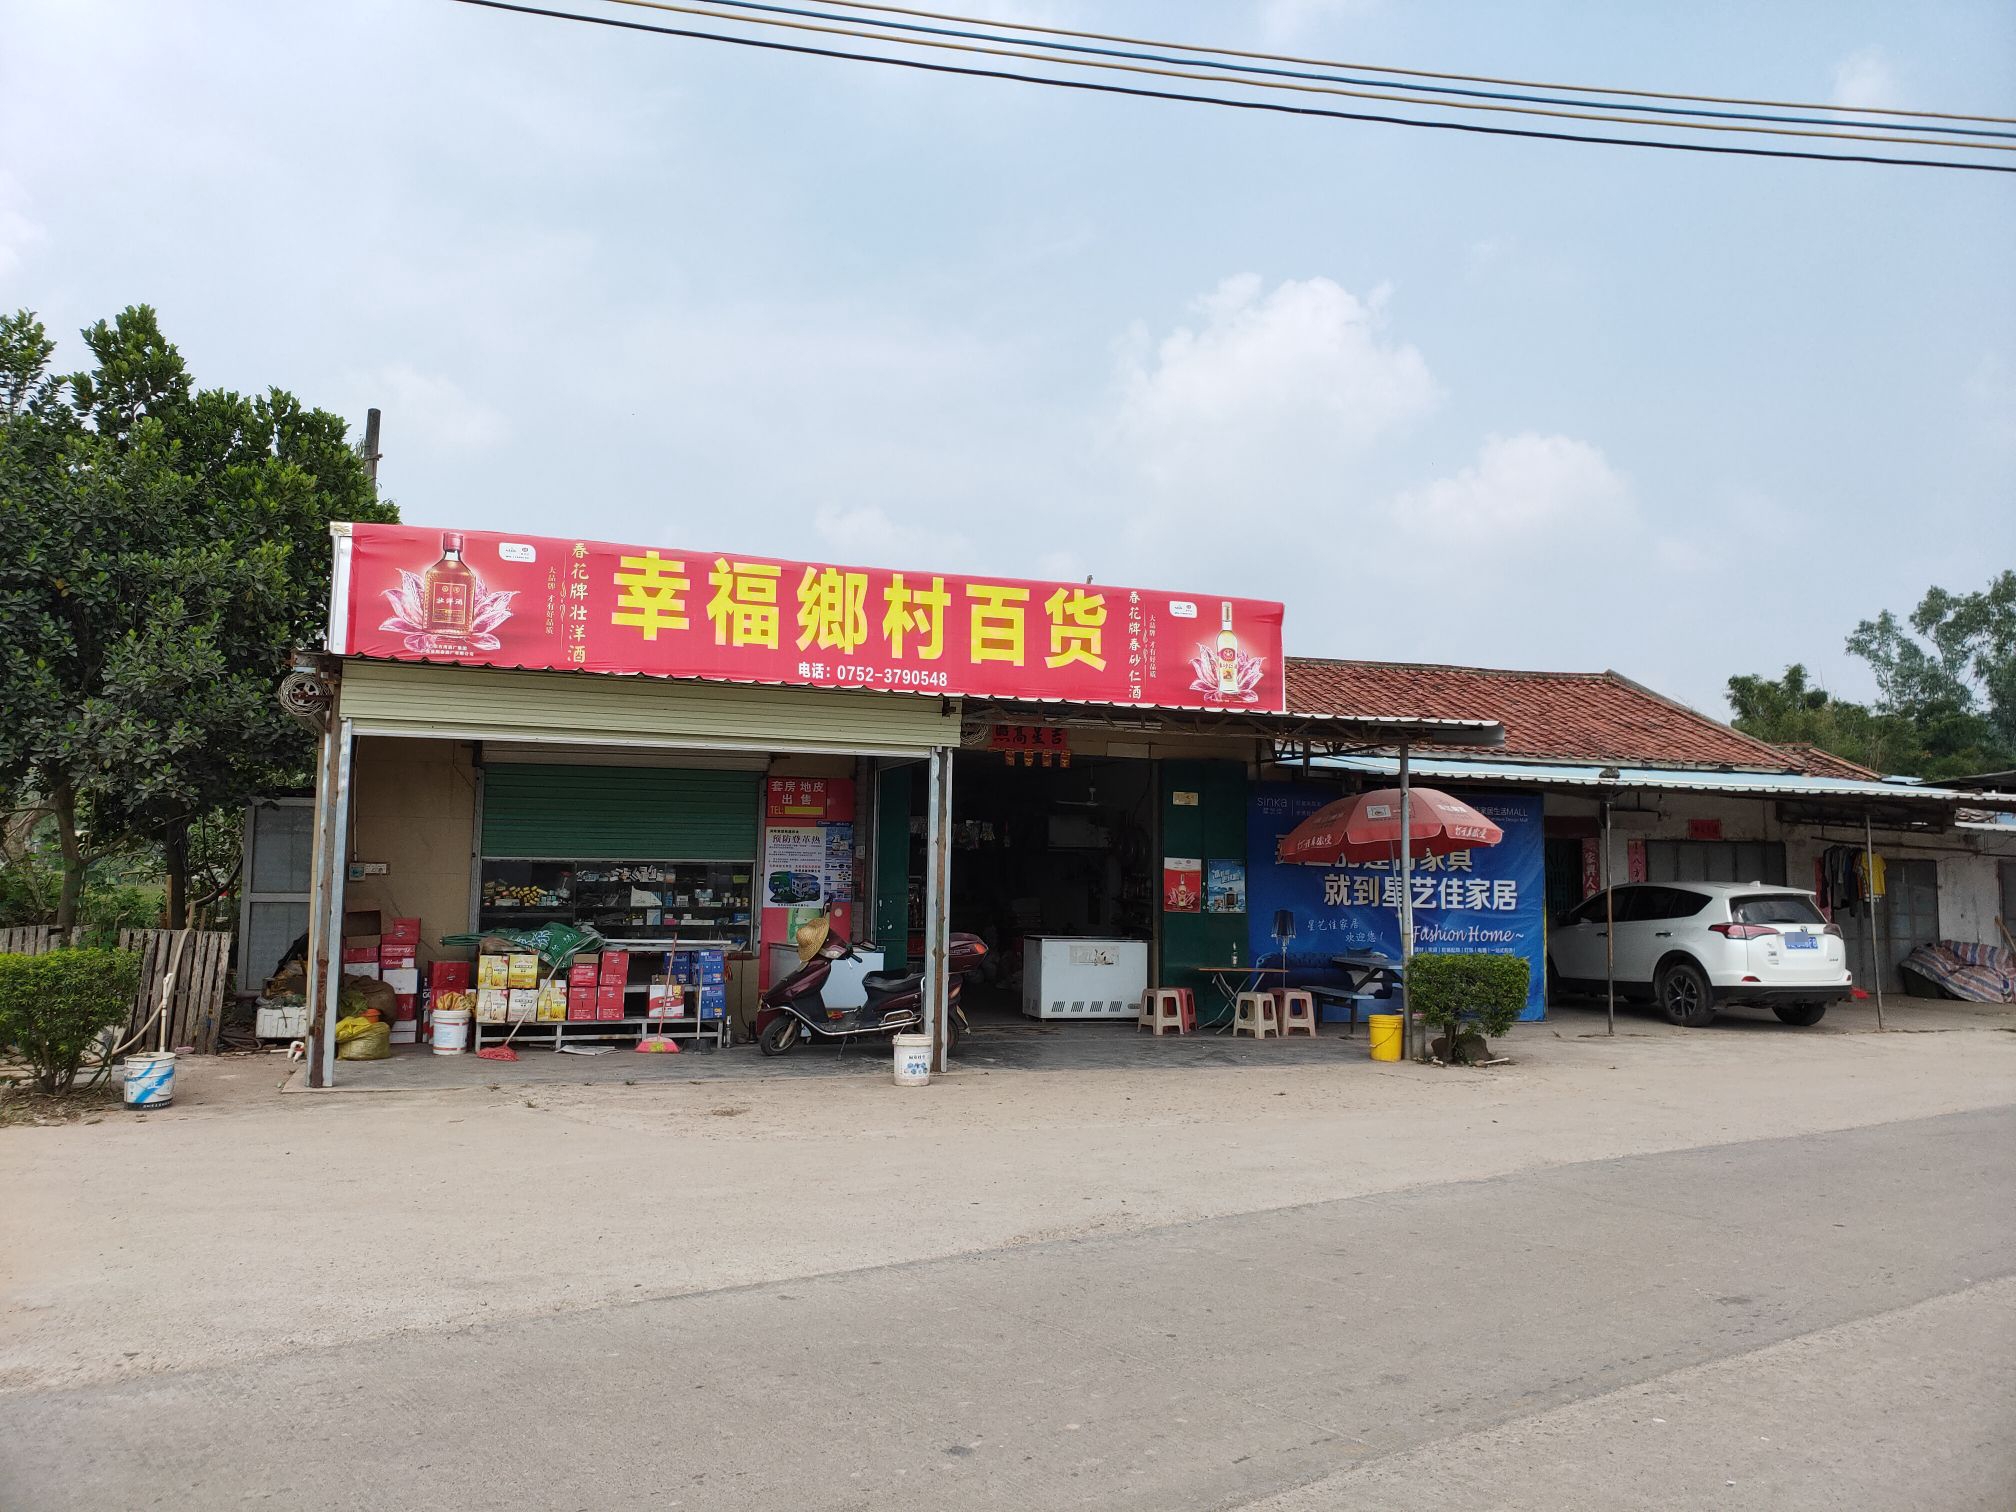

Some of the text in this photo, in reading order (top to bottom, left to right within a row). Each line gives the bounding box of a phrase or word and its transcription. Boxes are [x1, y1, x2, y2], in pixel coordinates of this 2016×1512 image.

[568, 542, 589, 664] 春花牌壮洋酒
[611, 550, 1108, 672] 幸福鄉村百货
[1128, 591, 1142, 700] 春花牌春砂仁酒
[836, 664, 949, 687] 0752-3790548
[771, 780, 825, 793] 套房 地皮
[781, 793, 812, 805] 出售
[1323, 873, 1518, 911] 就到星艺佳家居
[1413, 923, 1467, 943] Fashion
